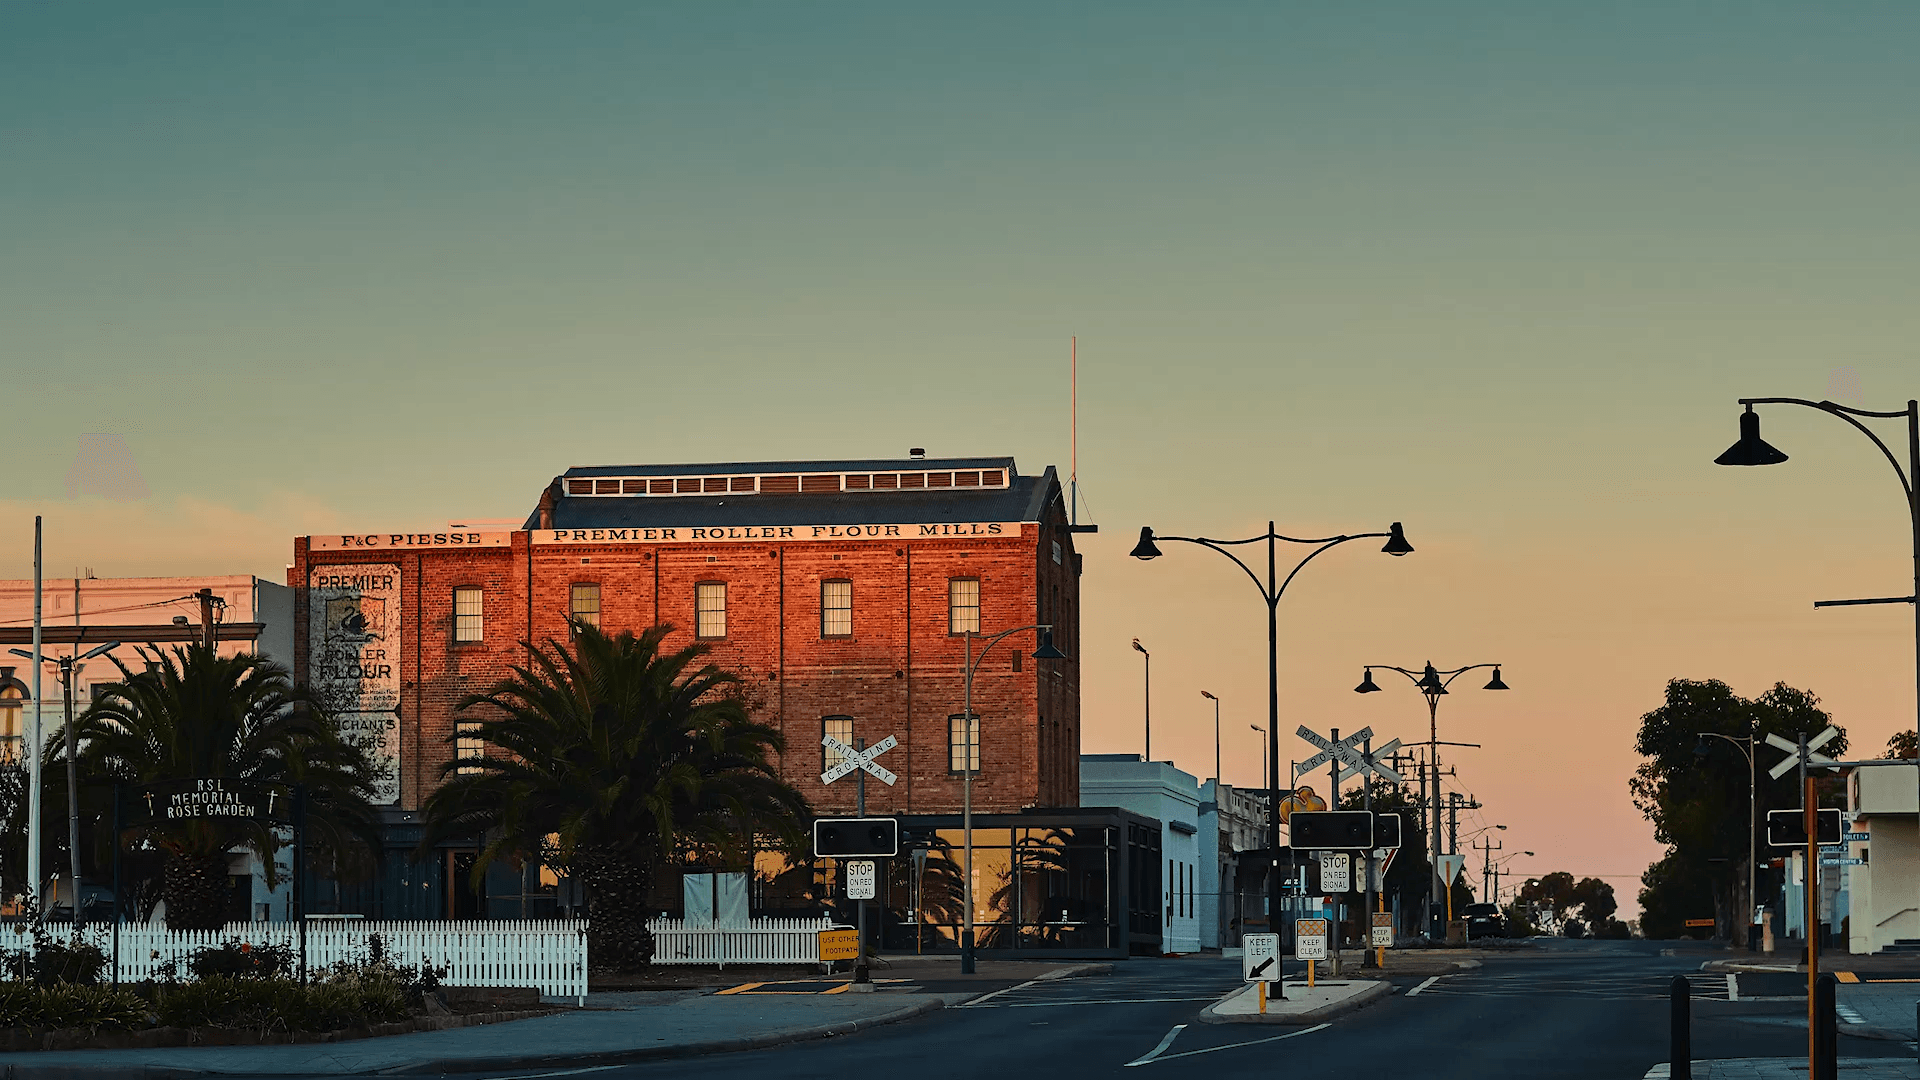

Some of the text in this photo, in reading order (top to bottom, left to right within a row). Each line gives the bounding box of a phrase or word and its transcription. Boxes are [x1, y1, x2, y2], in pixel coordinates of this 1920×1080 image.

[553, 523, 1003, 541] PREMIER ROLLER FLOUR MILLS
[341, 533, 481, 547] F&C PIESSE
[318, 575, 393, 590] PREMIER
[319, 664, 391, 679] FLOUR
[342, 719, 396, 731] CHANTS
[1301, 730, 1369, 772] CROSSING
[827, 738, 892, 781] CROSSING
[197, 778, 225, 792] RSL
[171, 791, 242, 806] MEMORIAL
[167, 803, 255, 819] ROSE GARDEN
[1323, 857, 1347, 868] STOP
[849, 864, 873, 876] STOP
[1324, 871, 1347, 879] ON RED
[850, 878, 873, 886] ON RED
[1323, 880, 1347, 889] SIGNAL
[850, 887, 872, 896] SIGNAL
[839, 935, 859, 943] OTHER
[1250, 938, 1273, 946] KEEP
[825, 946, 858, 955] FOOTPATH
[1250, 948, 1272, 956] LEFT
[1300, 947, 1323, 955] CLEAR
